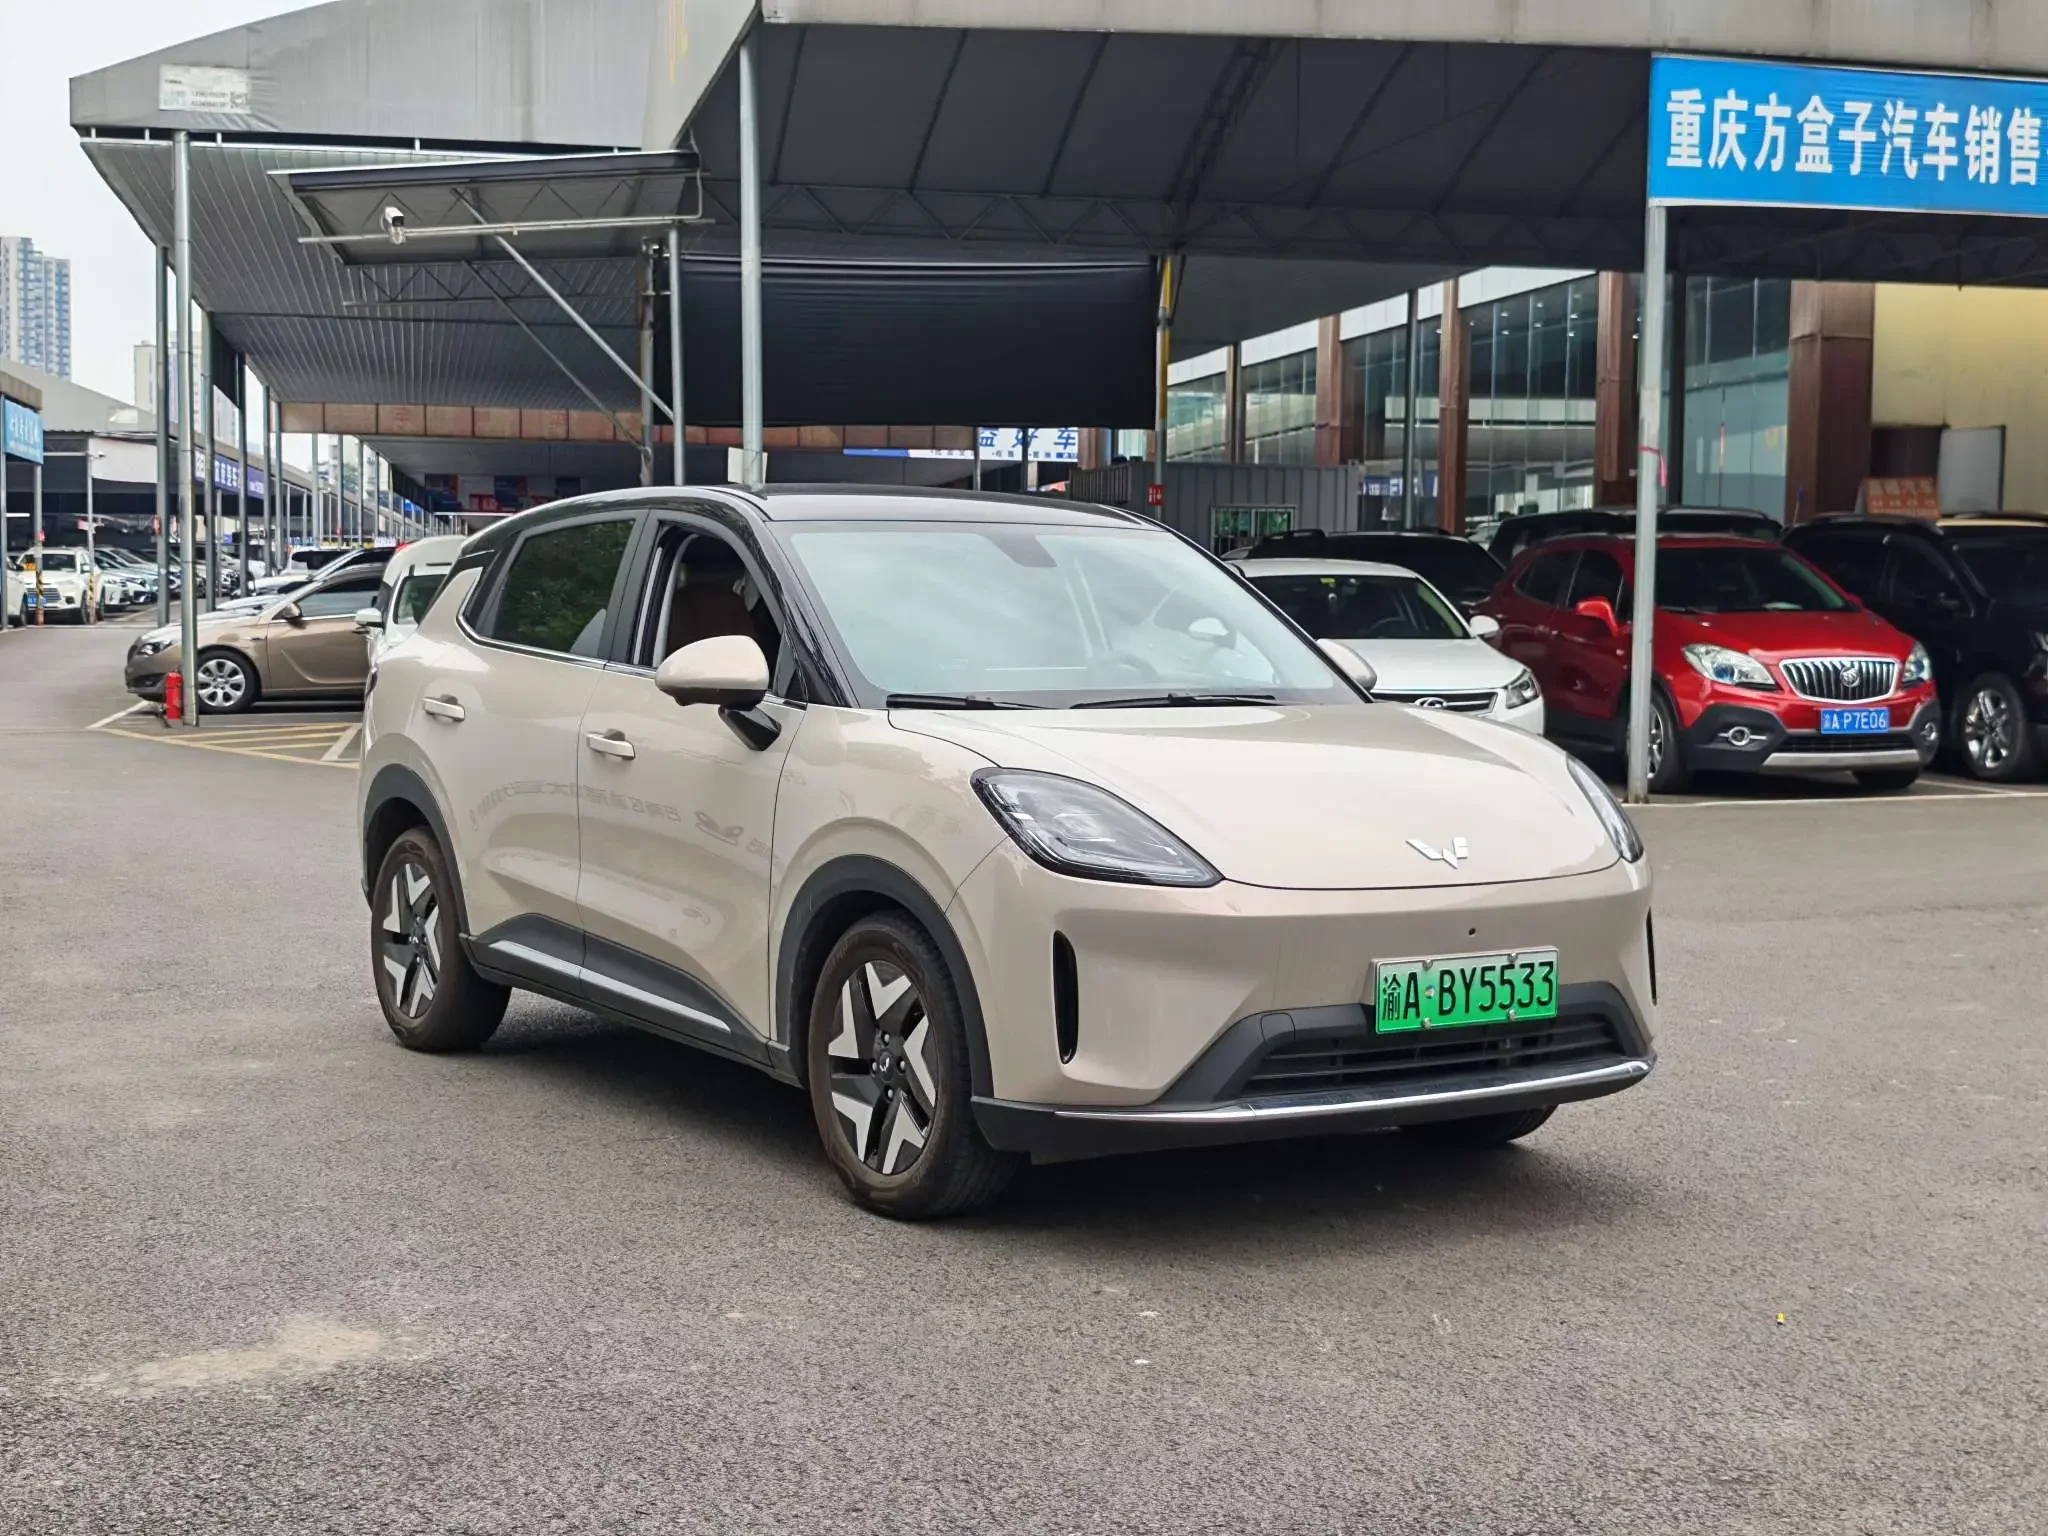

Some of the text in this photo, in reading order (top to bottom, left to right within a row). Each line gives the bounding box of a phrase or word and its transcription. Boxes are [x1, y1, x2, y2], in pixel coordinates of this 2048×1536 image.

[1666, 88, 2041, 185] 重庆方盒子汽车销售
